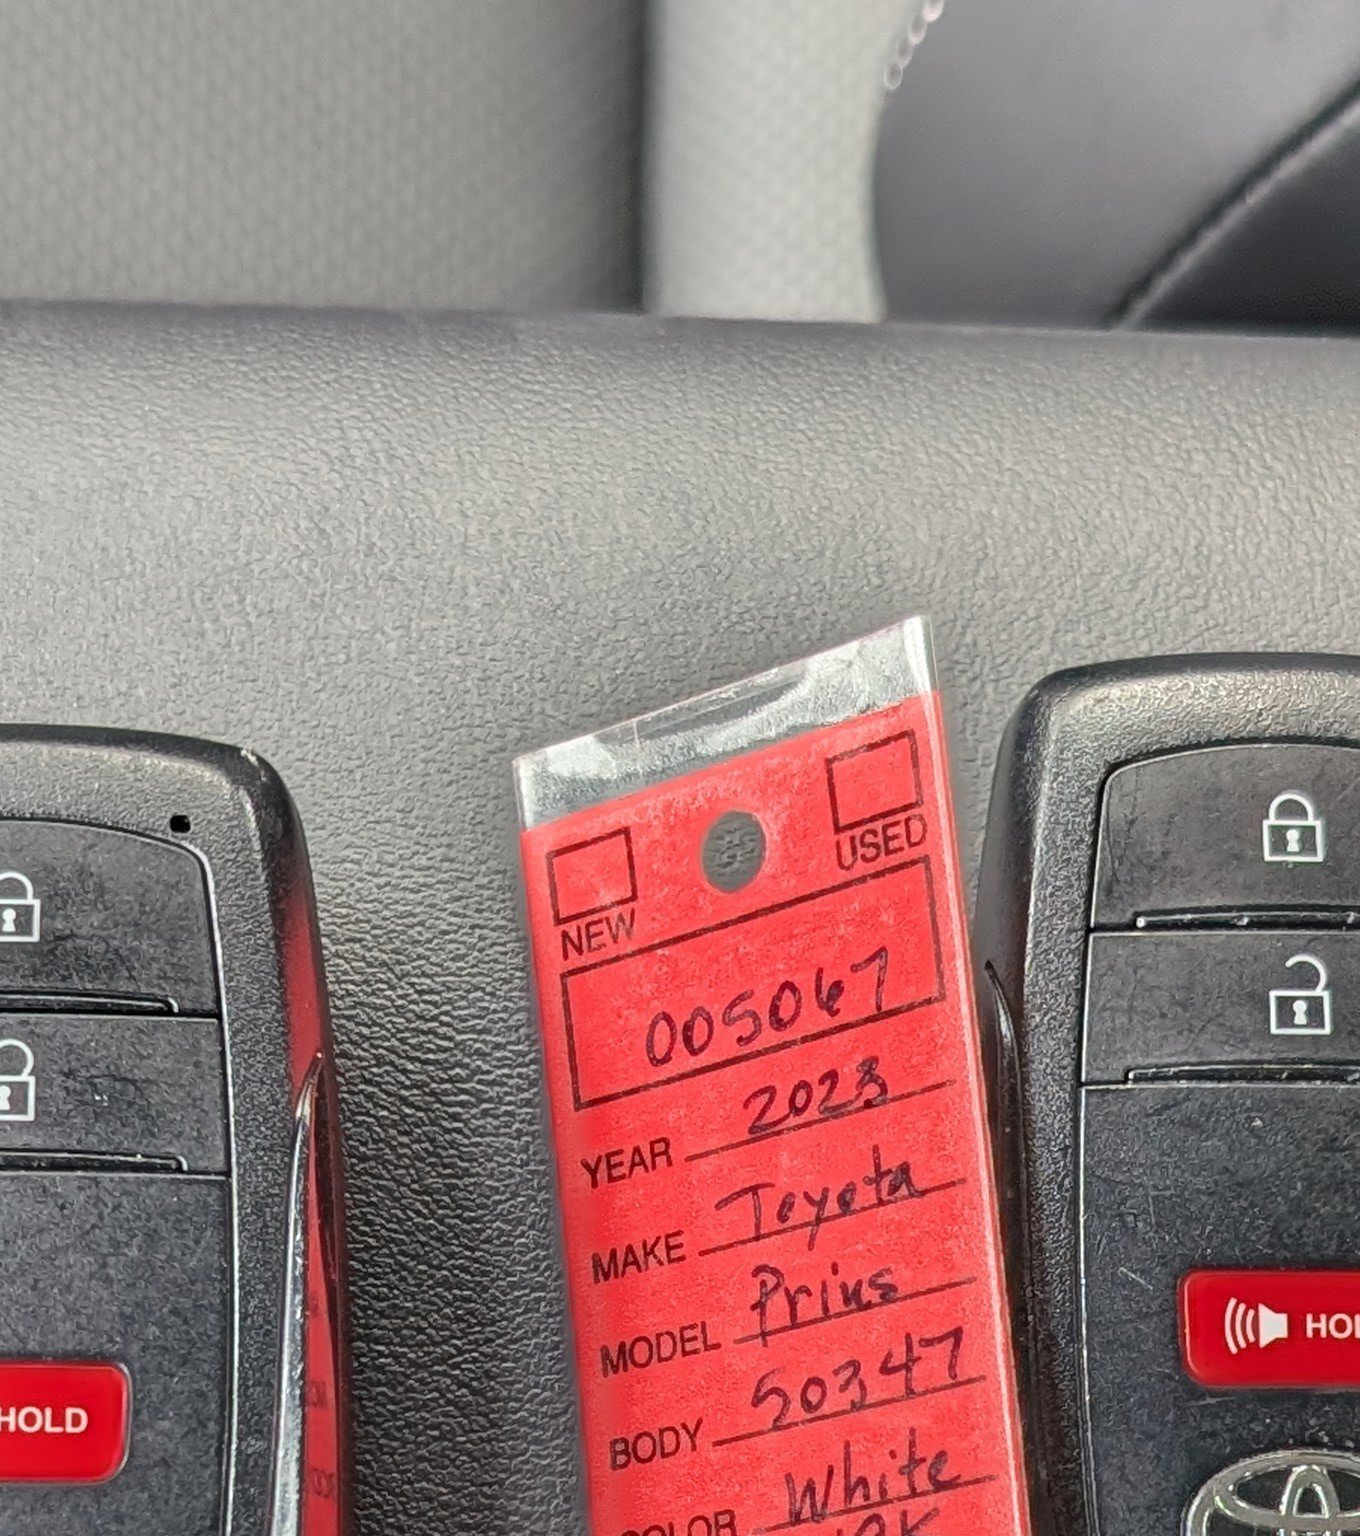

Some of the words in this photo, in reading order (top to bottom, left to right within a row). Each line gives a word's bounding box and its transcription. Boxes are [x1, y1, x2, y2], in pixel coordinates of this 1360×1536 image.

[835, 814, 929, 872] USED
[559, 908, 637, 962] NEW
[646, 947, 889, 1068] 005067
[580, 1137, 674, 1189] YEAR
[742, 1056, 889, 1135] 2023
[591, 1230, 686, 1284] MAKE
[715, 1143, 920, 1250] Toyota
[600, 1322, 721, 1378] MODEL
[749, 1261, 900, 1346] Prius
[609, 1418, 703, 1471] BODY
[749, 1327, 963, 1430] 50347
[785, 1427, 963, 1528] White
